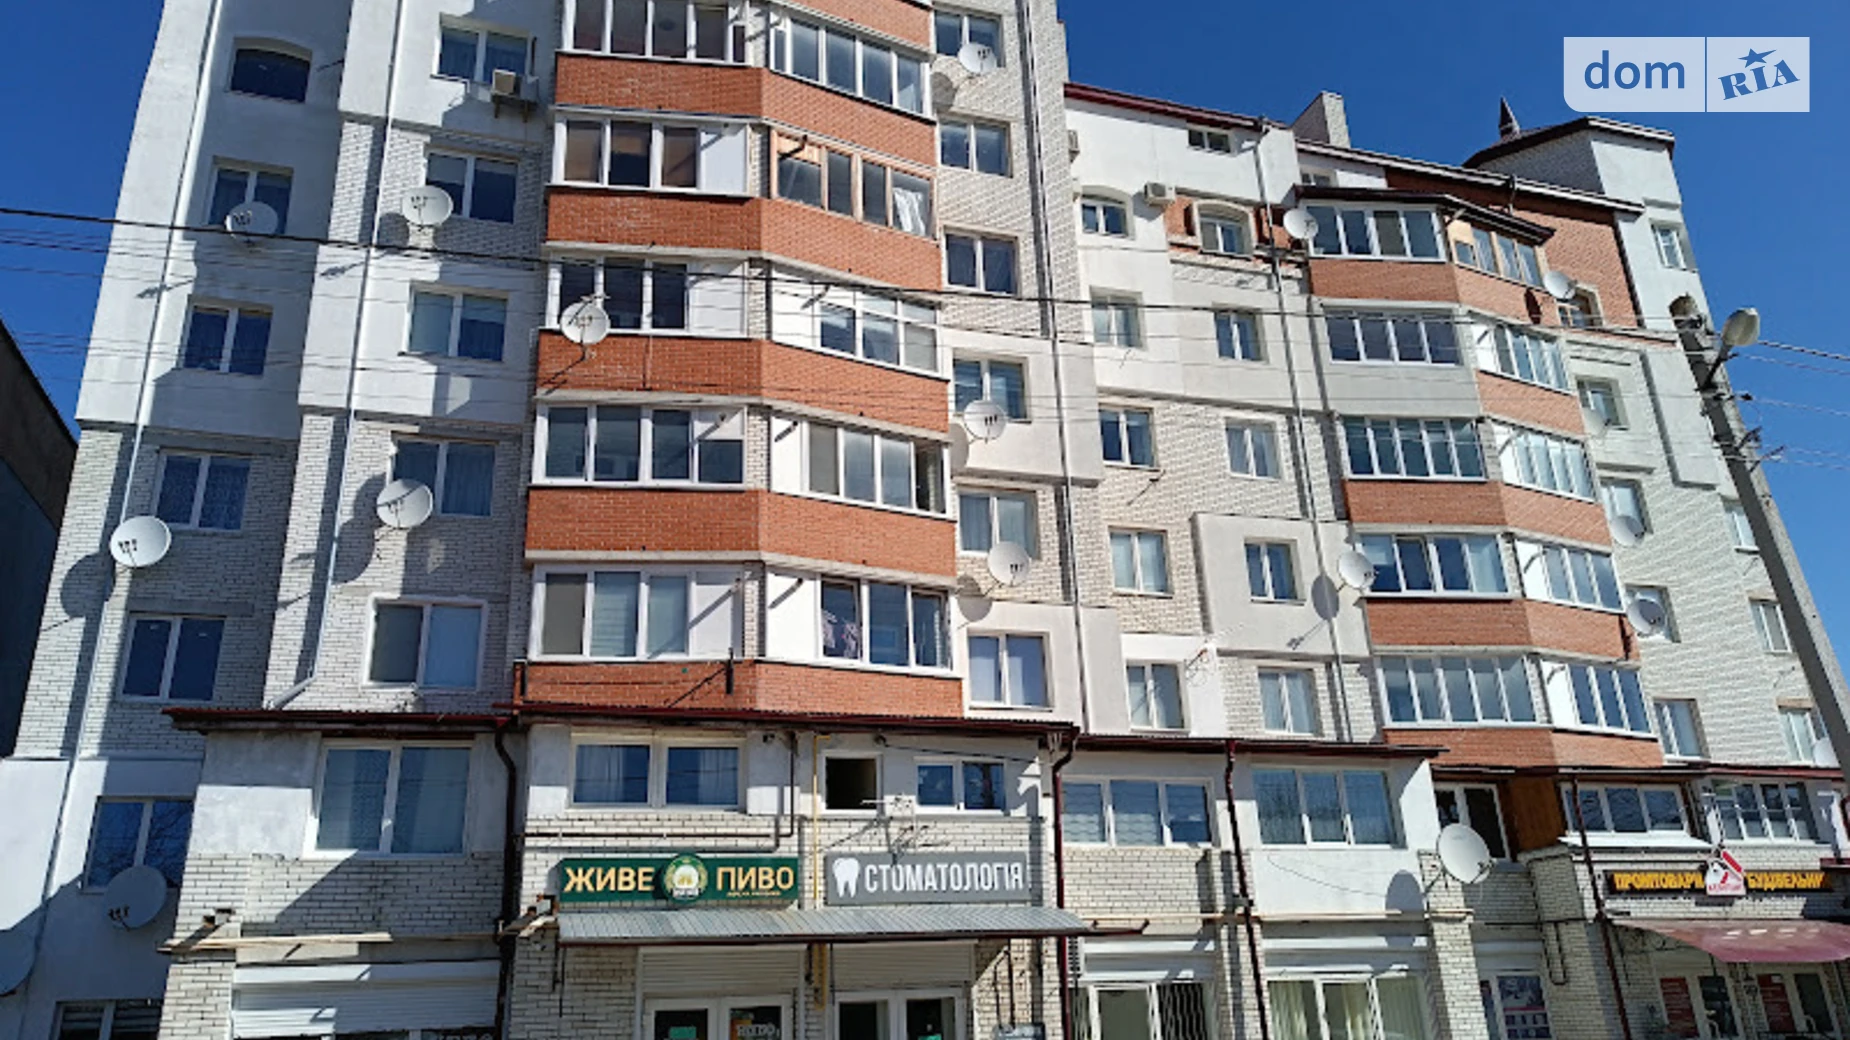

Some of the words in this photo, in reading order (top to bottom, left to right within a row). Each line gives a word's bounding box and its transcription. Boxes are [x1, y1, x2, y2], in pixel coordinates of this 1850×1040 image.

[563, 866, 655, 892] ЖИВЕ
[716, 866, 794, 891] ПИВО
[864, 862, 1024, 893] СТОМАТОЛОГІЯ
